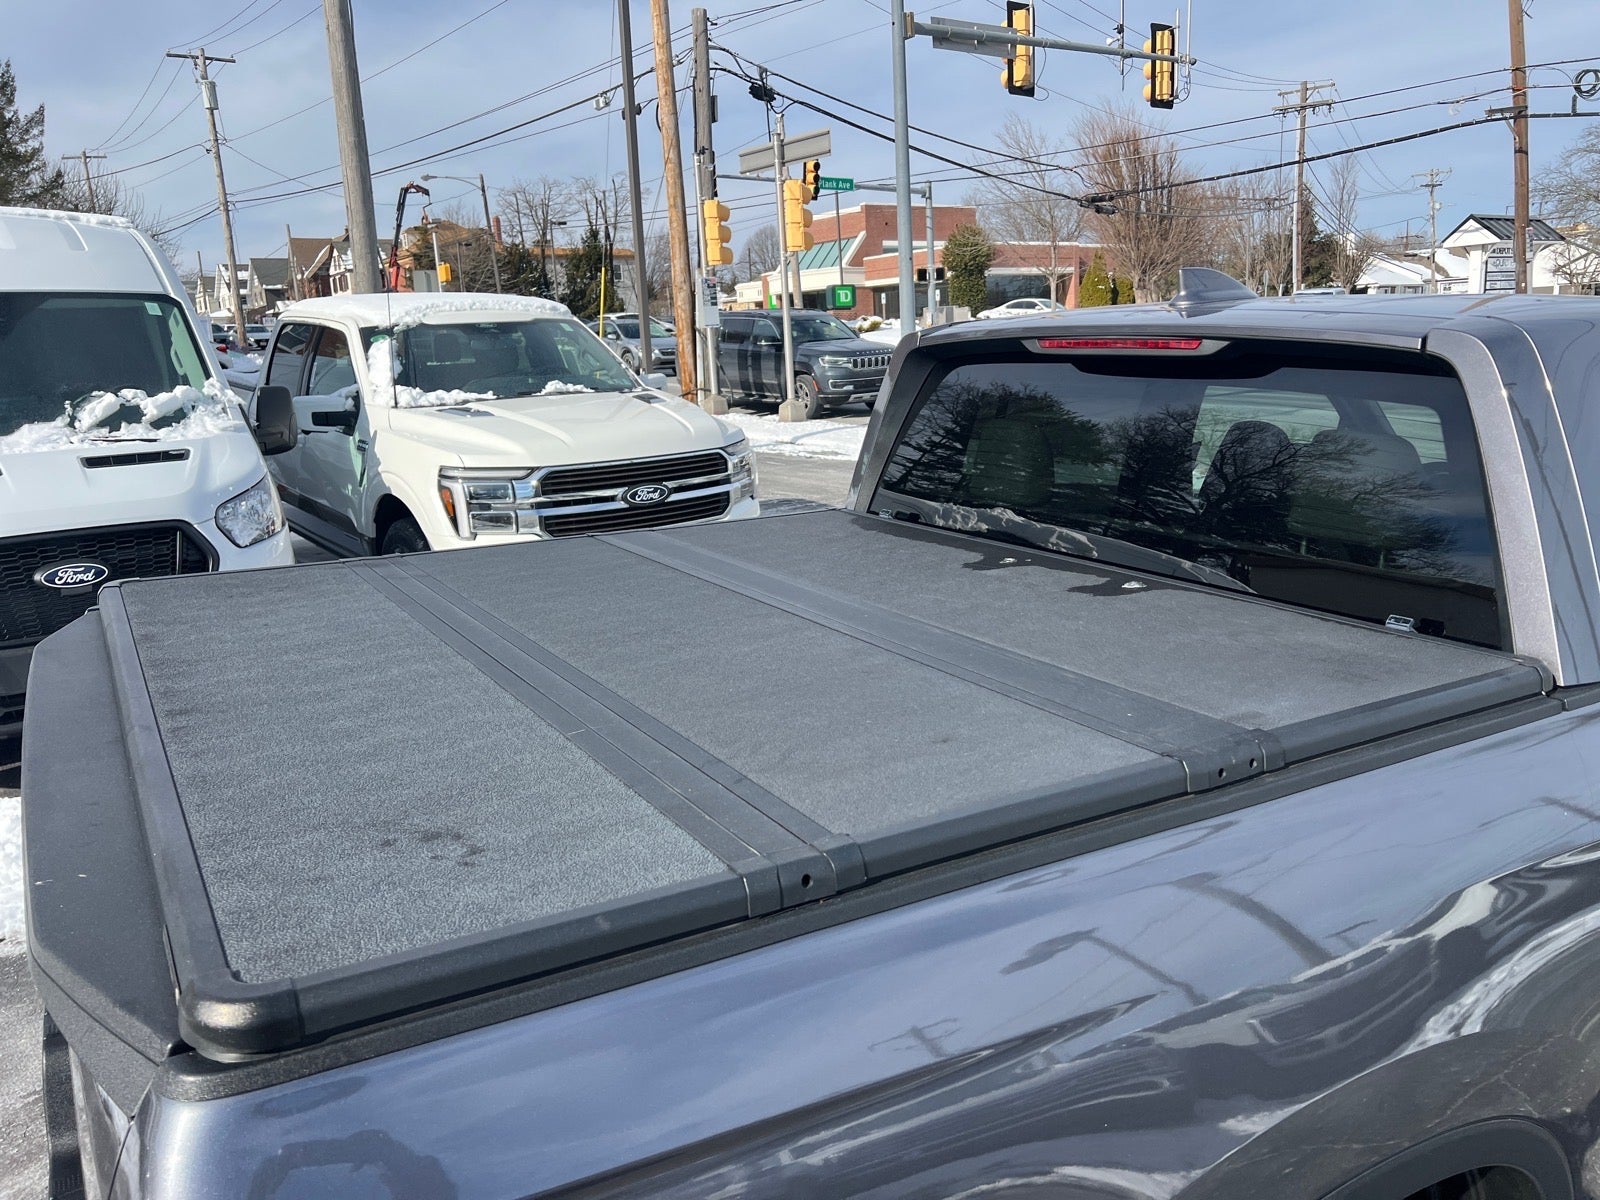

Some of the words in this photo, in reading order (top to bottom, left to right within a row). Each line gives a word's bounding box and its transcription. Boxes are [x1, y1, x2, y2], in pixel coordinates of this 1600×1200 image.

[838, 180, 851, 189] Ave
[837, 290, 851, 302] TD
[635, 487, 661, 501] Ford
[54, 567, 96, 585] Ford
